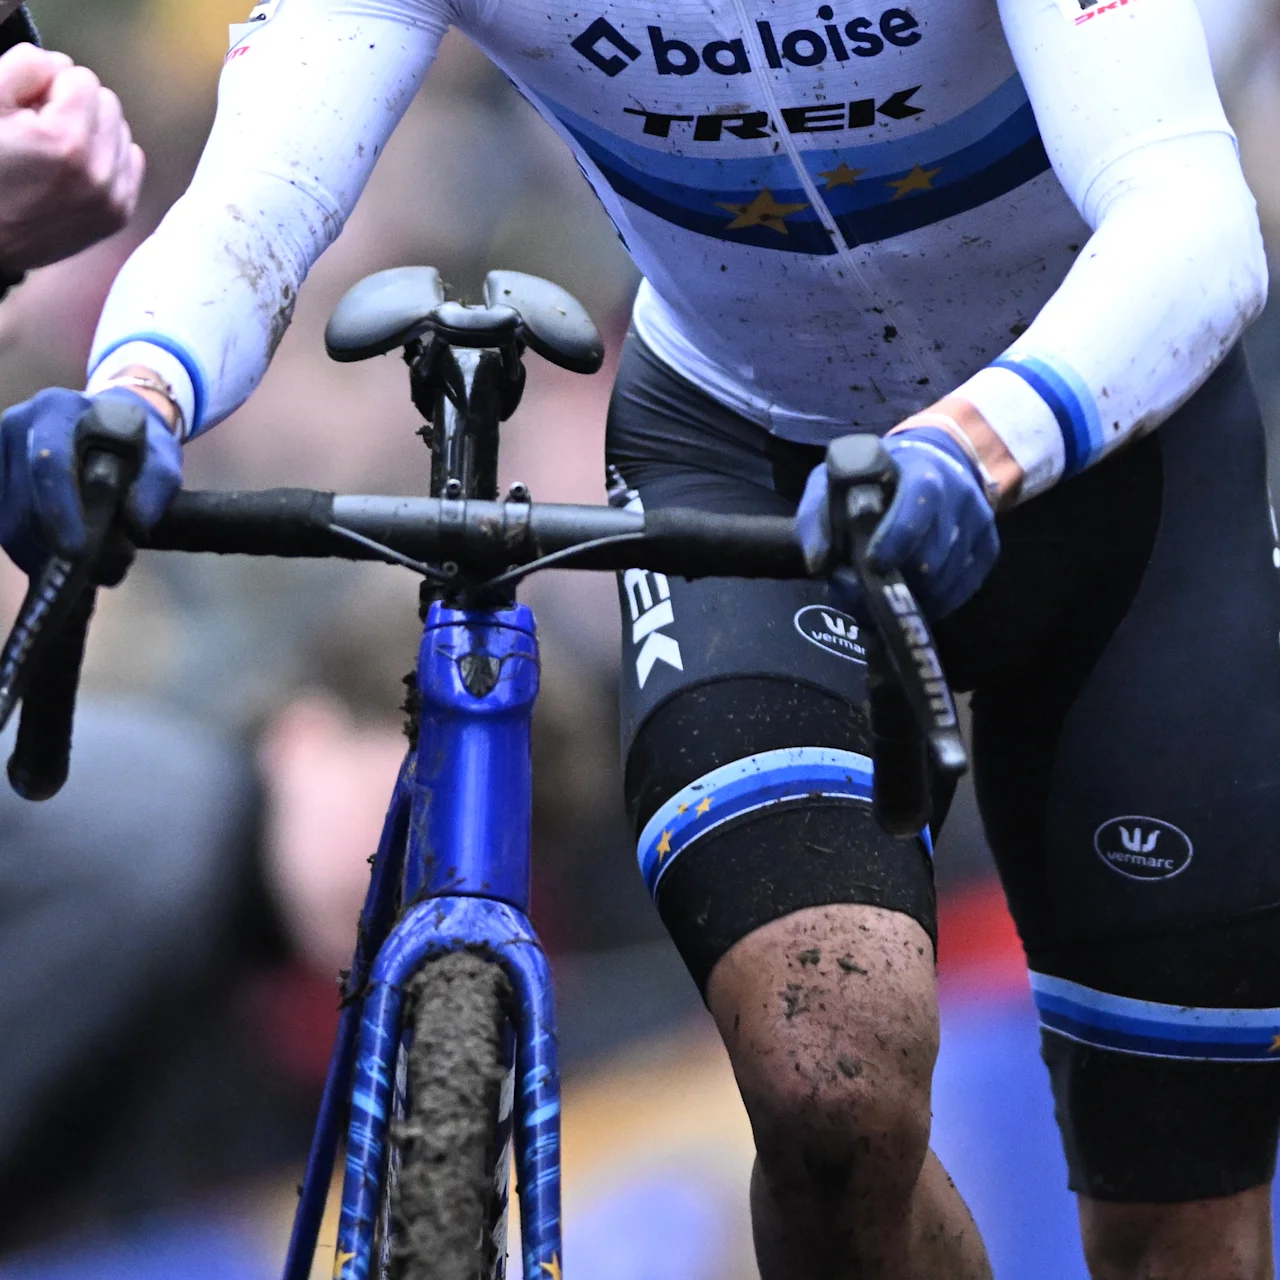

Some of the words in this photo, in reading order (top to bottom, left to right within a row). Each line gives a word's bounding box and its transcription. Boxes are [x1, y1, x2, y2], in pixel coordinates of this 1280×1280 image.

[648, 4, 922, 76] baloise
[622, 84, 926, 142] TREK
[811, 630, 867, 655] vermar
[882, 582, 957, 727] SRAM
[1106, 851, 1175, 870] vermarc
